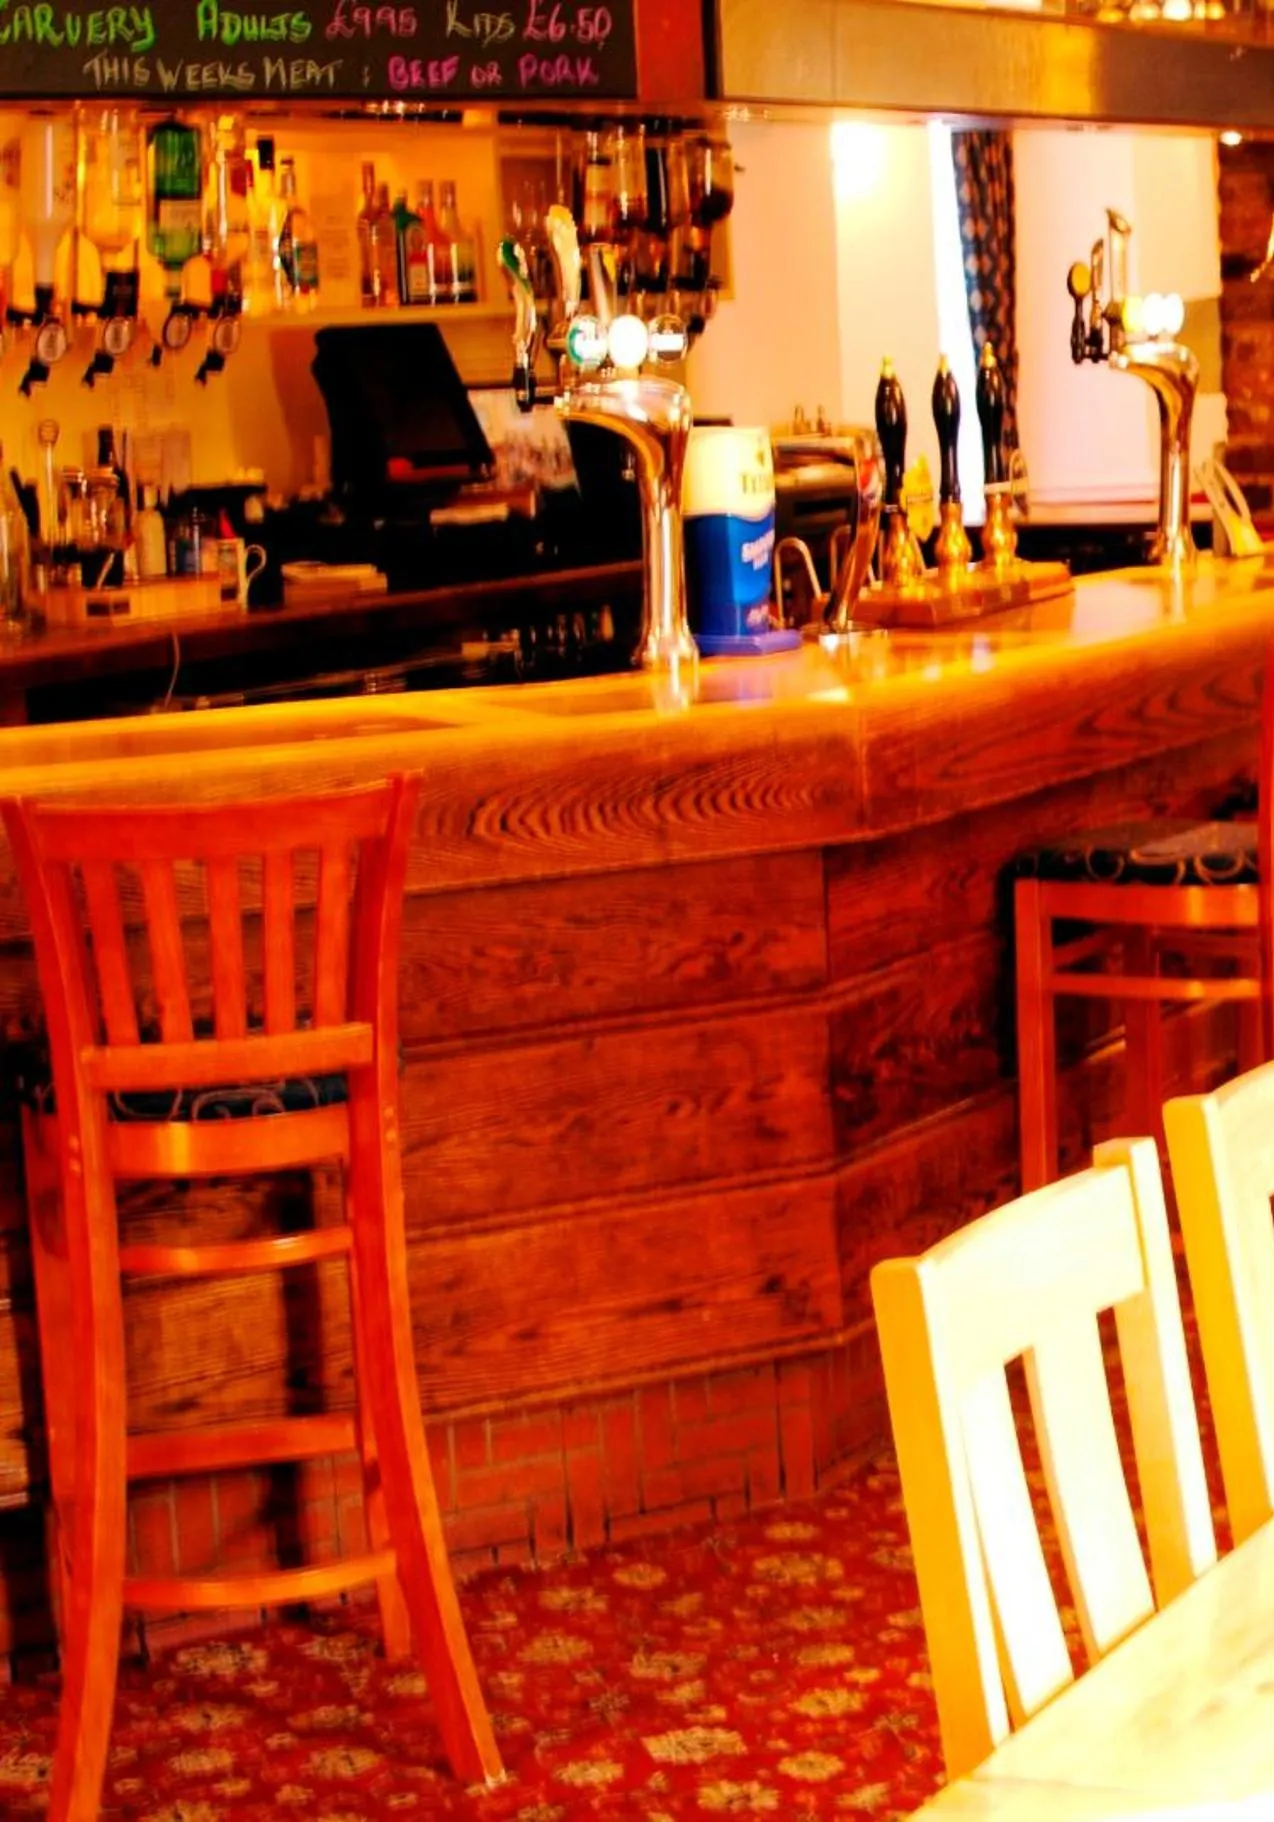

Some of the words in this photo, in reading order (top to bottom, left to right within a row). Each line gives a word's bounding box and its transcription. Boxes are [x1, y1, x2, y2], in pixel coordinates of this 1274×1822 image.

[196, 0, 313, 46] ADULTS
[445, 0, 515, 48] KIDS
[522, 0, 613, 50] £6.50
[83, 52, 150, 89] THIS
[156, 57, 255, 93] WEEKS
[262, 55, 343, 90] MEAT
[388, 55, 459, 90] BEEF
[470, 64, 503, 88] OR
[518, 54, 599, 89] PORK
